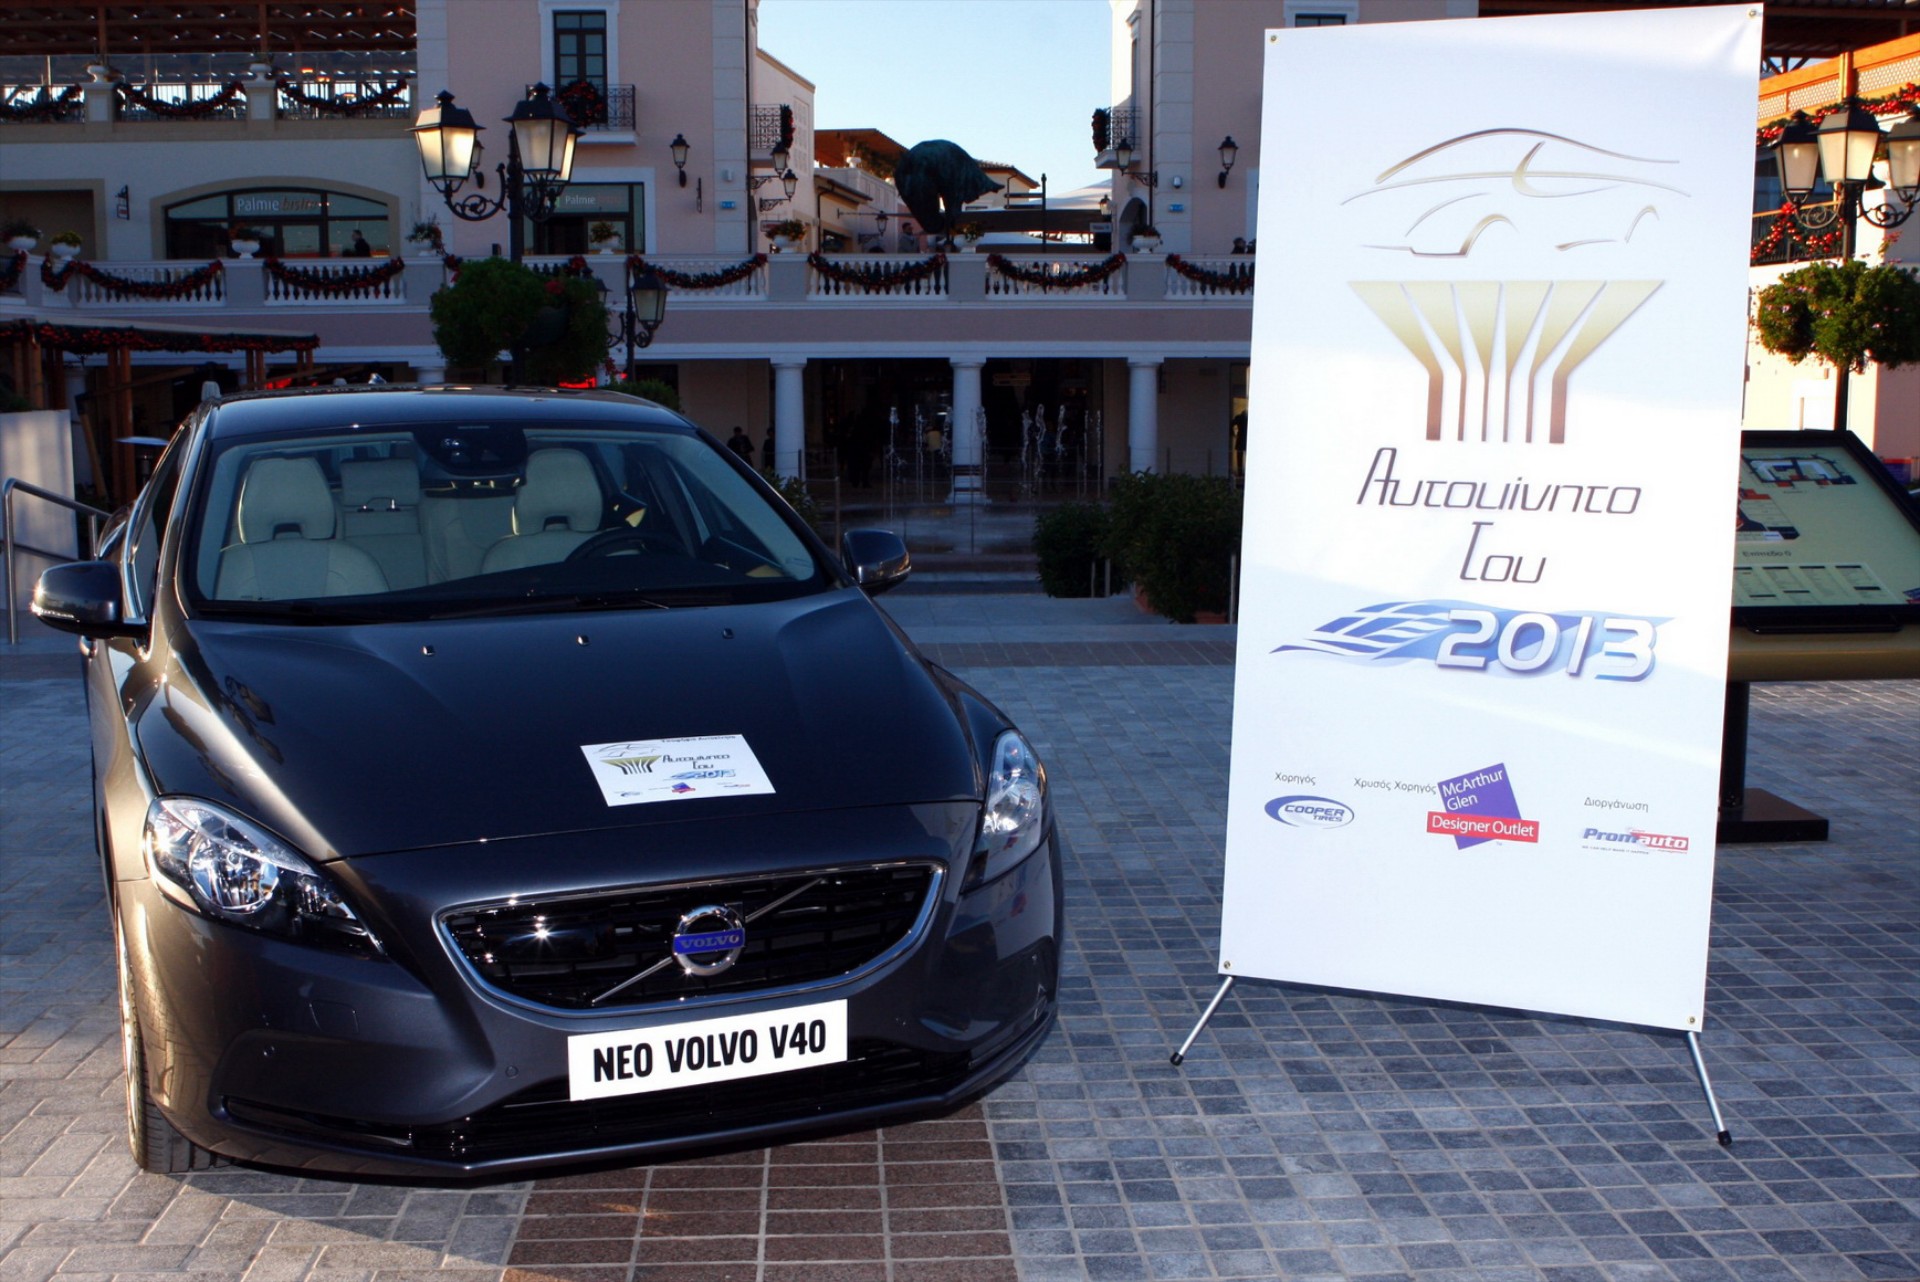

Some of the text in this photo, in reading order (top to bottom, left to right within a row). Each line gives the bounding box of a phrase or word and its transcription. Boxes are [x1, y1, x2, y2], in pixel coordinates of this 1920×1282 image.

[238, 197, 279, 211] Palmie
[1435, 608, 1658, 683] 2013
[1275, 772, 1316, 786] Χορηγός
[1354, 777, 1437, 795] Χρυσός Χορηγός
[1442, 770, 1504, 797] McArthur
[1284, 804, 1345, 817] COOPER
[1447, 794, 1478, 811] Glen
[1584, 797, 1649, 813] Διοργάνωση
[1313, 814, 1342, 823] TIRES
[1432, 815, 1534, 837] Designer Outlet
[680, 934, 740, 949] VOLVO
[593, 1019, 826, 1083] NEO VOLVO V40
